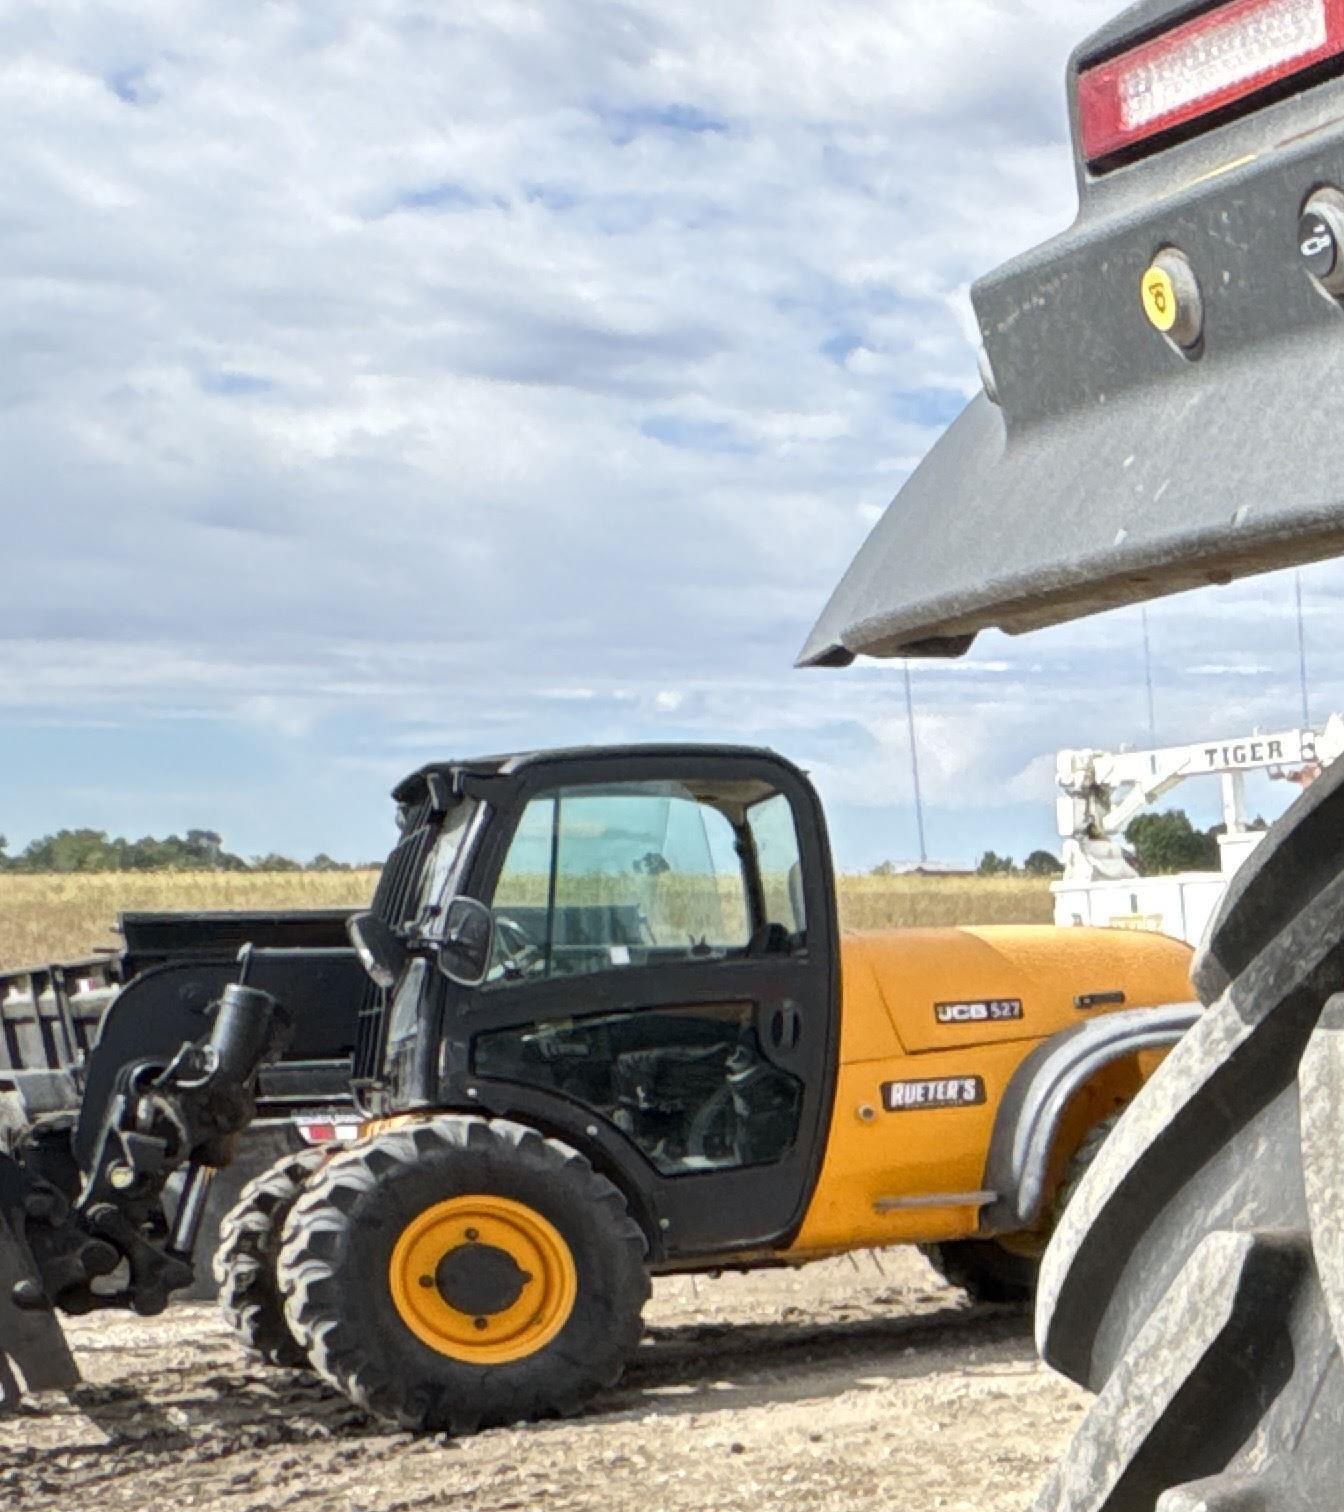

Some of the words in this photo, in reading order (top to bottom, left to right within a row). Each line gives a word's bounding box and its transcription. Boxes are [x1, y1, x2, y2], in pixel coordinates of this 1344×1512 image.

[1204, 741, 1283, 766] TIGER
[937, 1004, 988, 1022] JCB
[890, 1078, 977, 1107] RUETER'S
